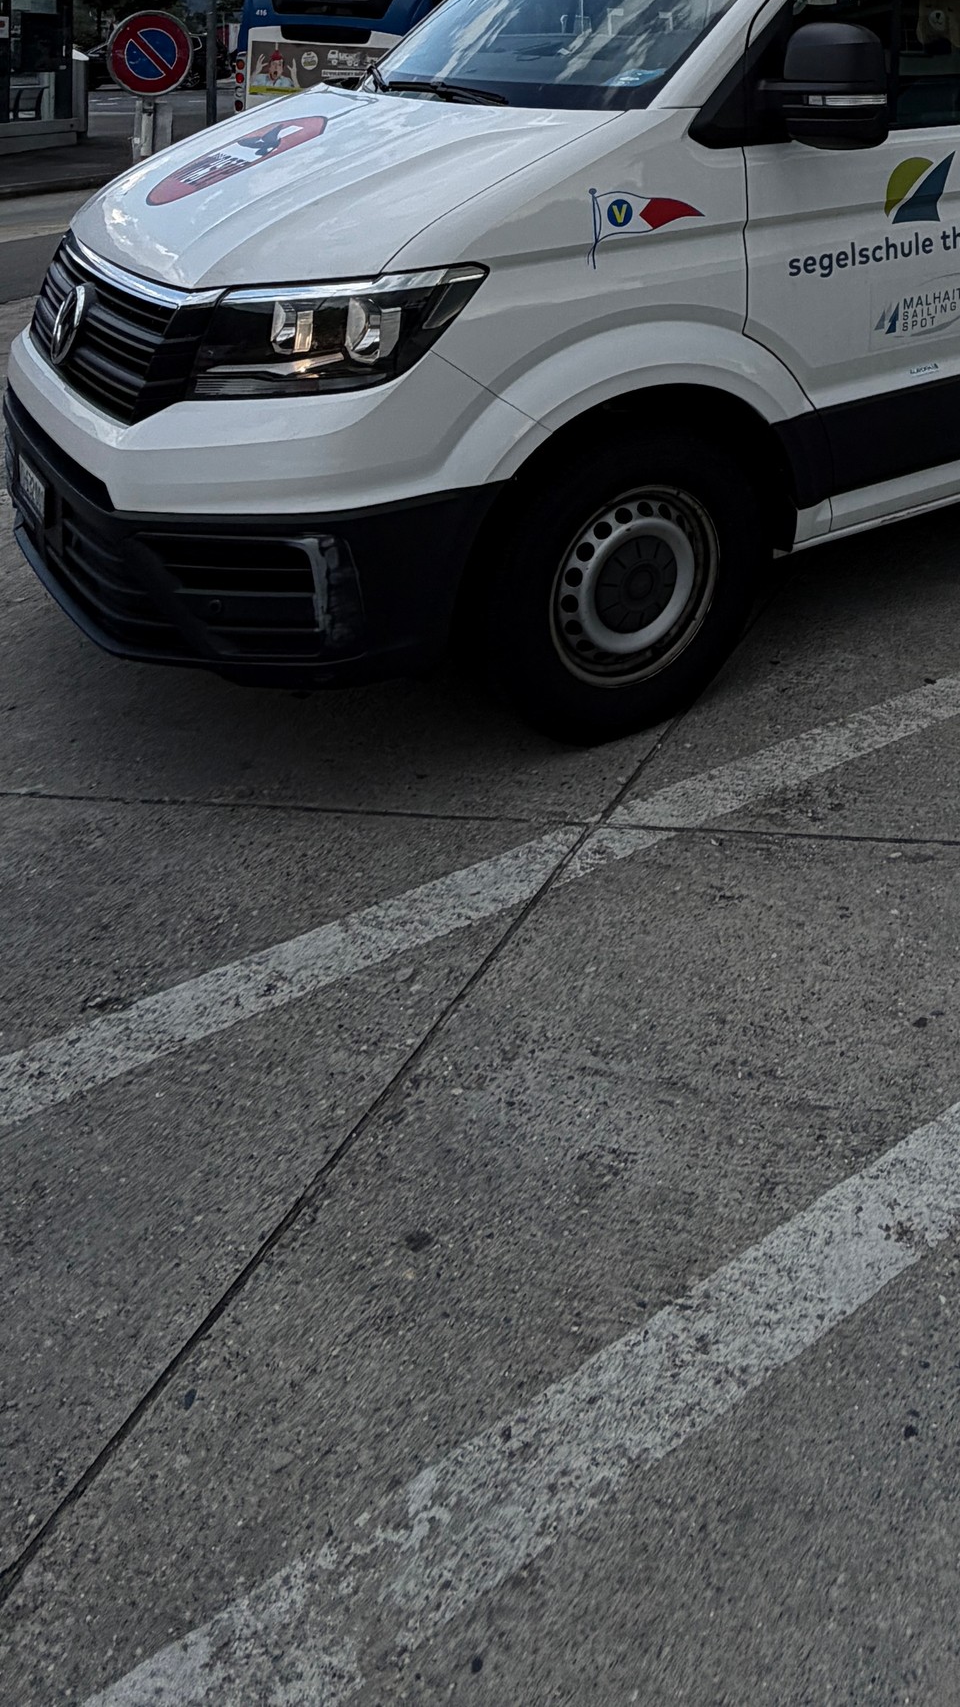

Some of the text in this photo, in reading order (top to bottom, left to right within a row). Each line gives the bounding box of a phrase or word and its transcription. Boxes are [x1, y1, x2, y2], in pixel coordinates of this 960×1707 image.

[612, 203, 628, 225] V
[788, 231, 934, 278] segelschule
[902, 301, 957, 321] SAILING
[902, 316, 936, 332] SPOT
